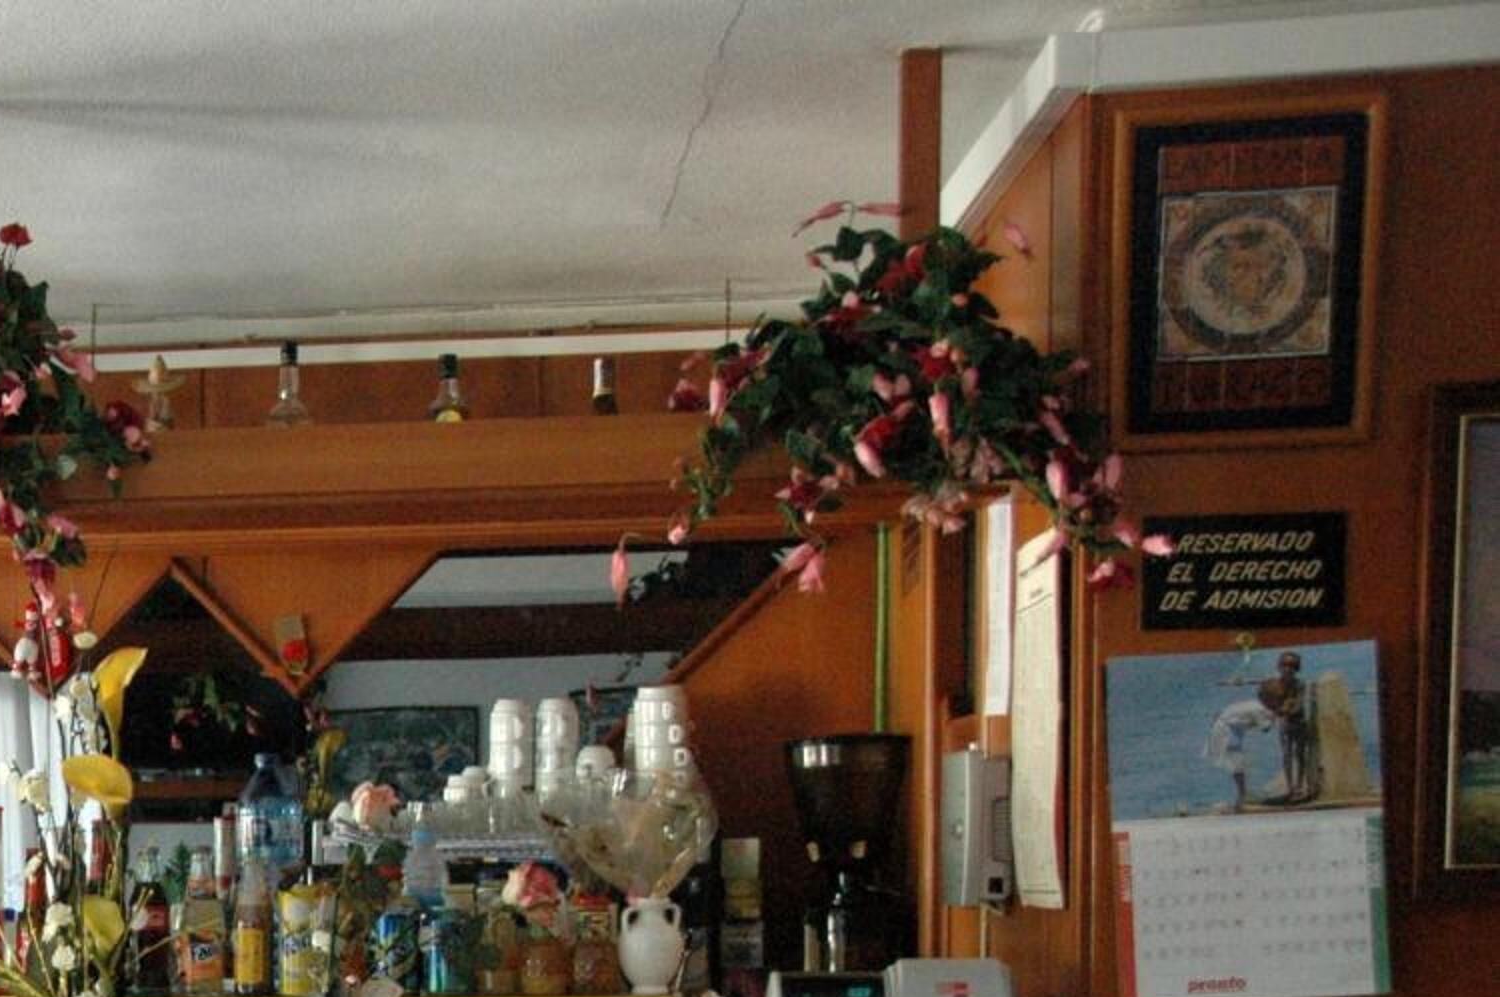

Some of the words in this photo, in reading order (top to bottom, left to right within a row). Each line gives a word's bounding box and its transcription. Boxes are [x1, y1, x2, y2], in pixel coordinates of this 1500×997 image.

[1177, 531, 1316, 554] RESERVADO
[1166, 562, 1195, 583] EL
[1209, 559, 1323, 582] DERECHO
[1159, 590, 1197, 611] DE
[1203, 588, 1324, 610] ADMISION
